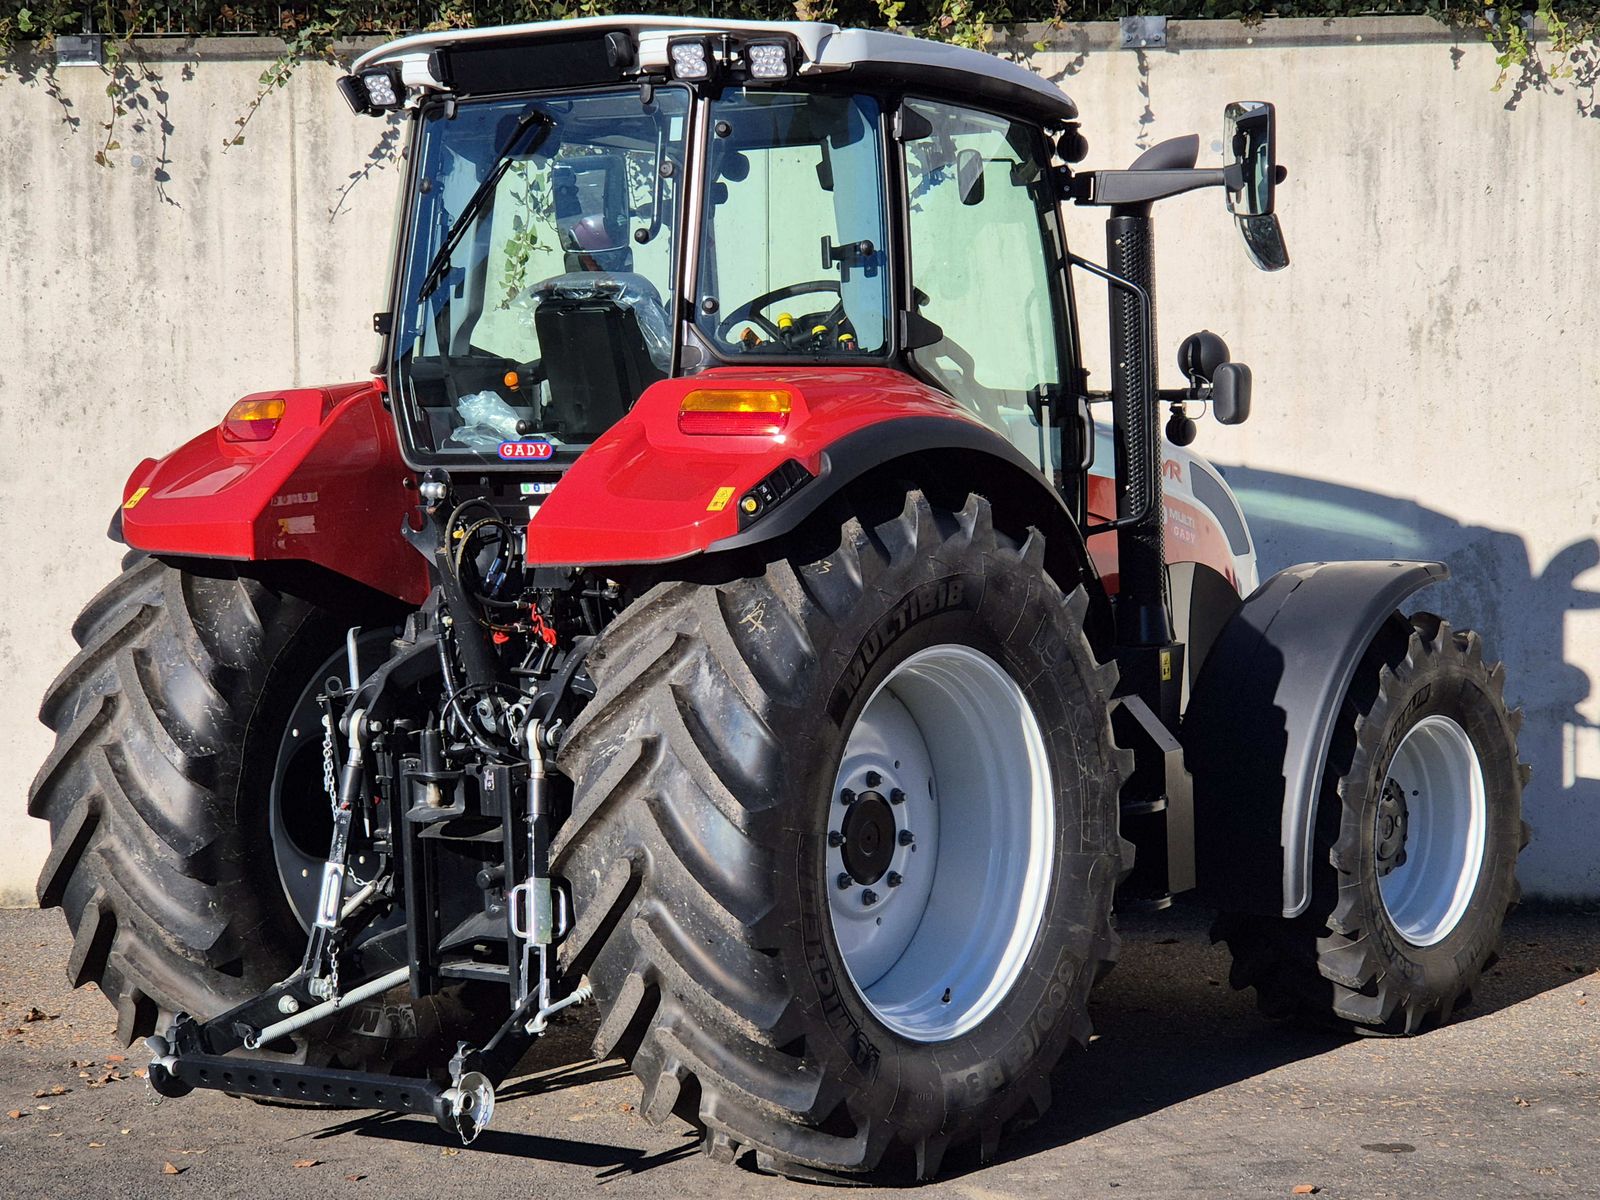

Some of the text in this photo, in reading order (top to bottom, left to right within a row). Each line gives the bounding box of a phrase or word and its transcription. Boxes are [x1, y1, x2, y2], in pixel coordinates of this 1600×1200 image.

[503, 444, 547, 457] GADY
[1169, 507, 1195, 529] MULTI
[842, 580, 965, 699] MULTIBIB
